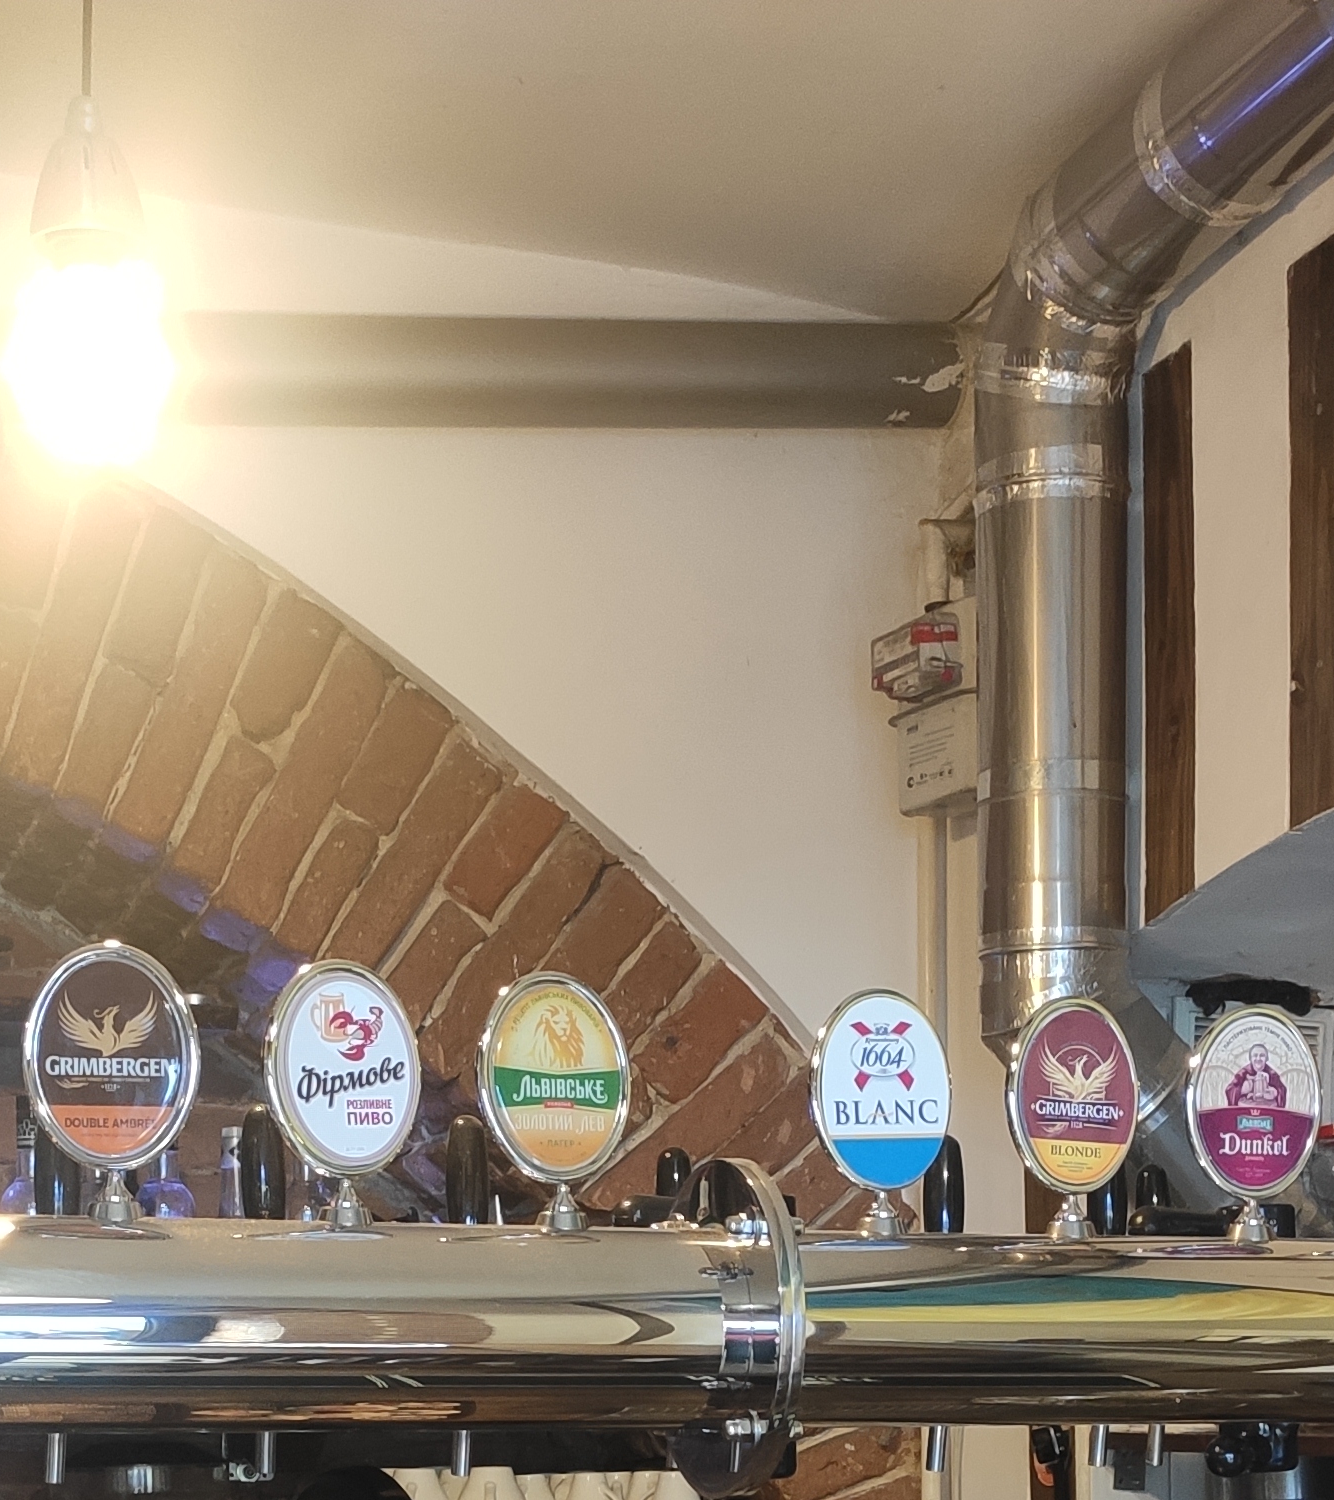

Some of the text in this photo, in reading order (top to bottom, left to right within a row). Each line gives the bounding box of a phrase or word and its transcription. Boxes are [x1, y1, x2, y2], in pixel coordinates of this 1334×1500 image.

[45, 1055, 180, 1078] GRIMBERGEN
[860, 1043, 908, 1069] 1664
[297, 1056, 405, 1109] Фірмове
[513, 1074, 608, 1104] ЛЬВІВСЬКЕ
[347, 1098, 393, 1110] РОЗЛИВНЕ
[833, 1099, 939, 1125] BLANC
[1035, 1099, 1119, 1120] GRIMBERGEN
[64, 1117, 110, 1128] DOUBLE
[347, 1111, 394, 1126] ПИВО
[515, 1112, 605, 1135] ЗОЛОТИЙ ЛЕВ
[1050, 1145, 1102, 1159] BLONDE
